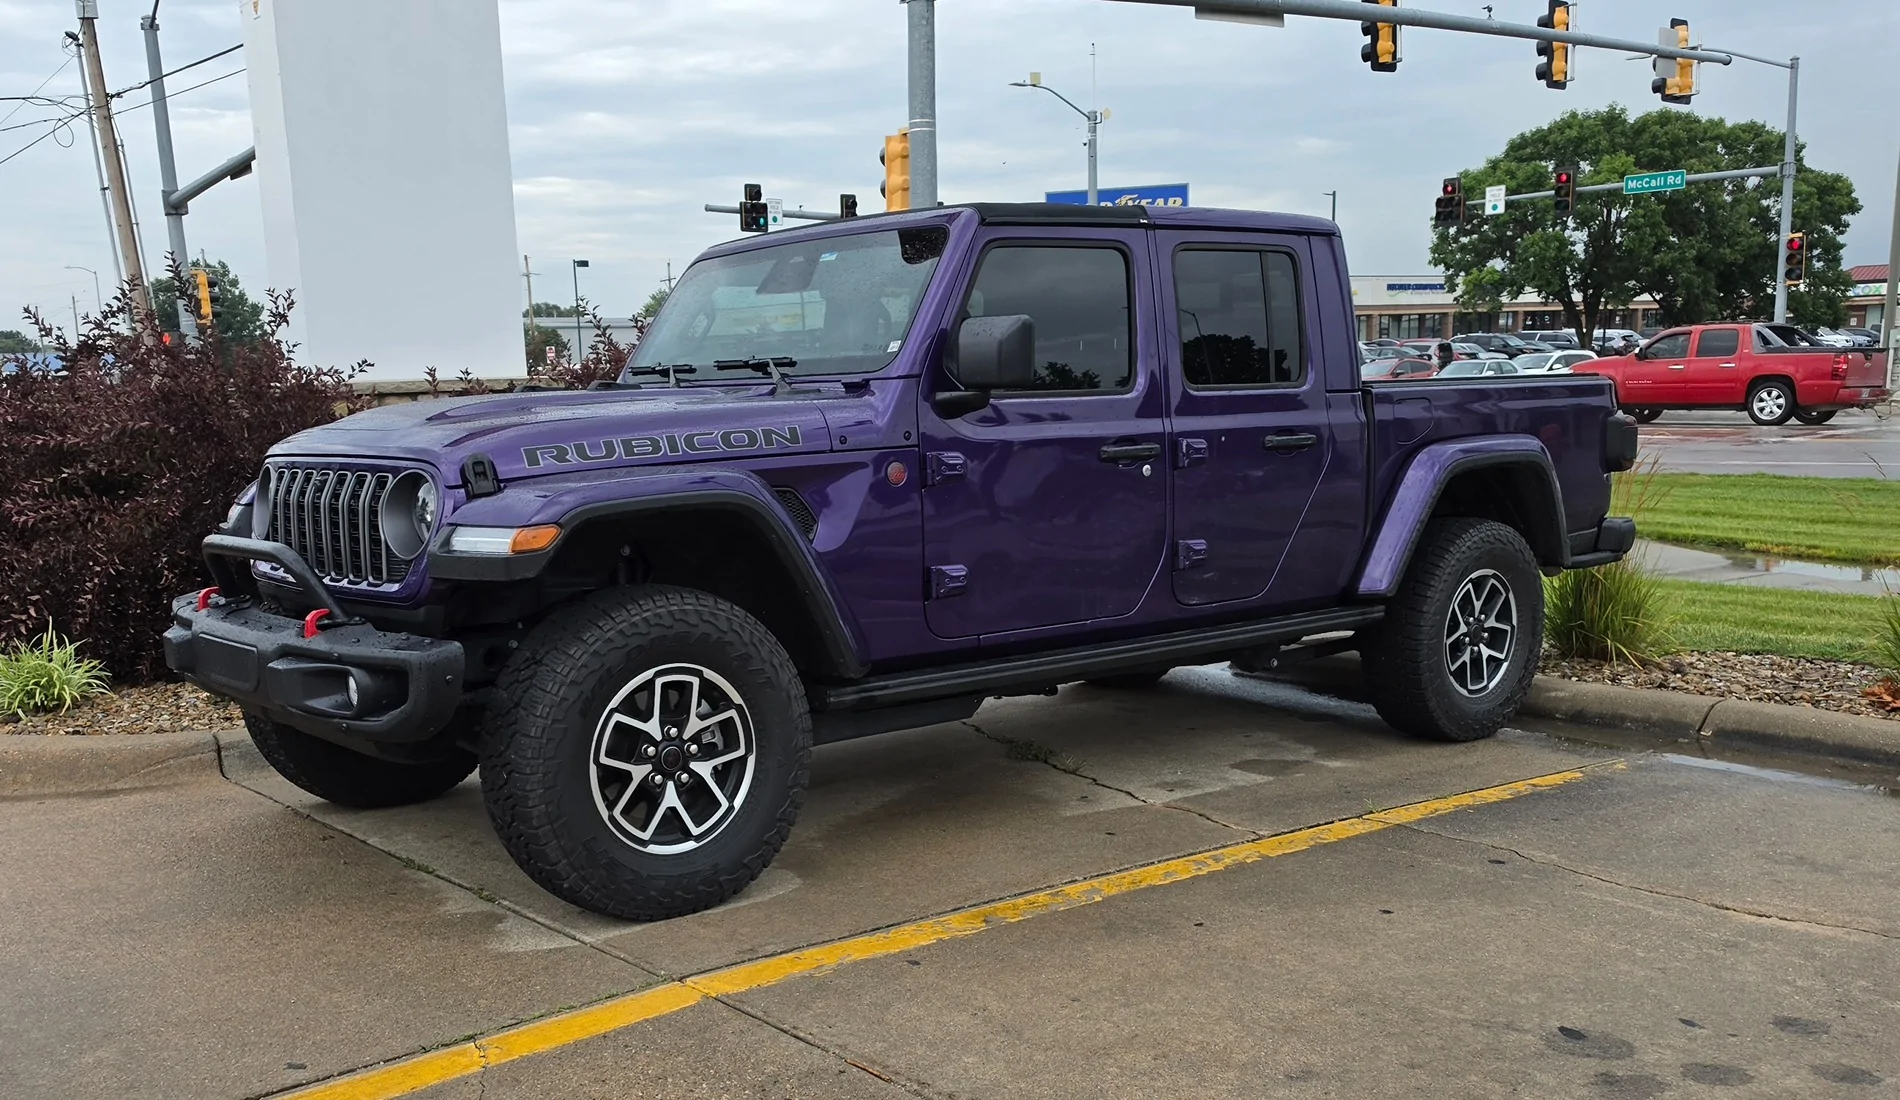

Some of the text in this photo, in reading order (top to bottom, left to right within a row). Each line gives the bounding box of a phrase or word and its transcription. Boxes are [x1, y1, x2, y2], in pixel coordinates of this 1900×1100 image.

[1628, 175, 1682, 189] McCall Rd
[521, 425, 802, 468] RUBICON
